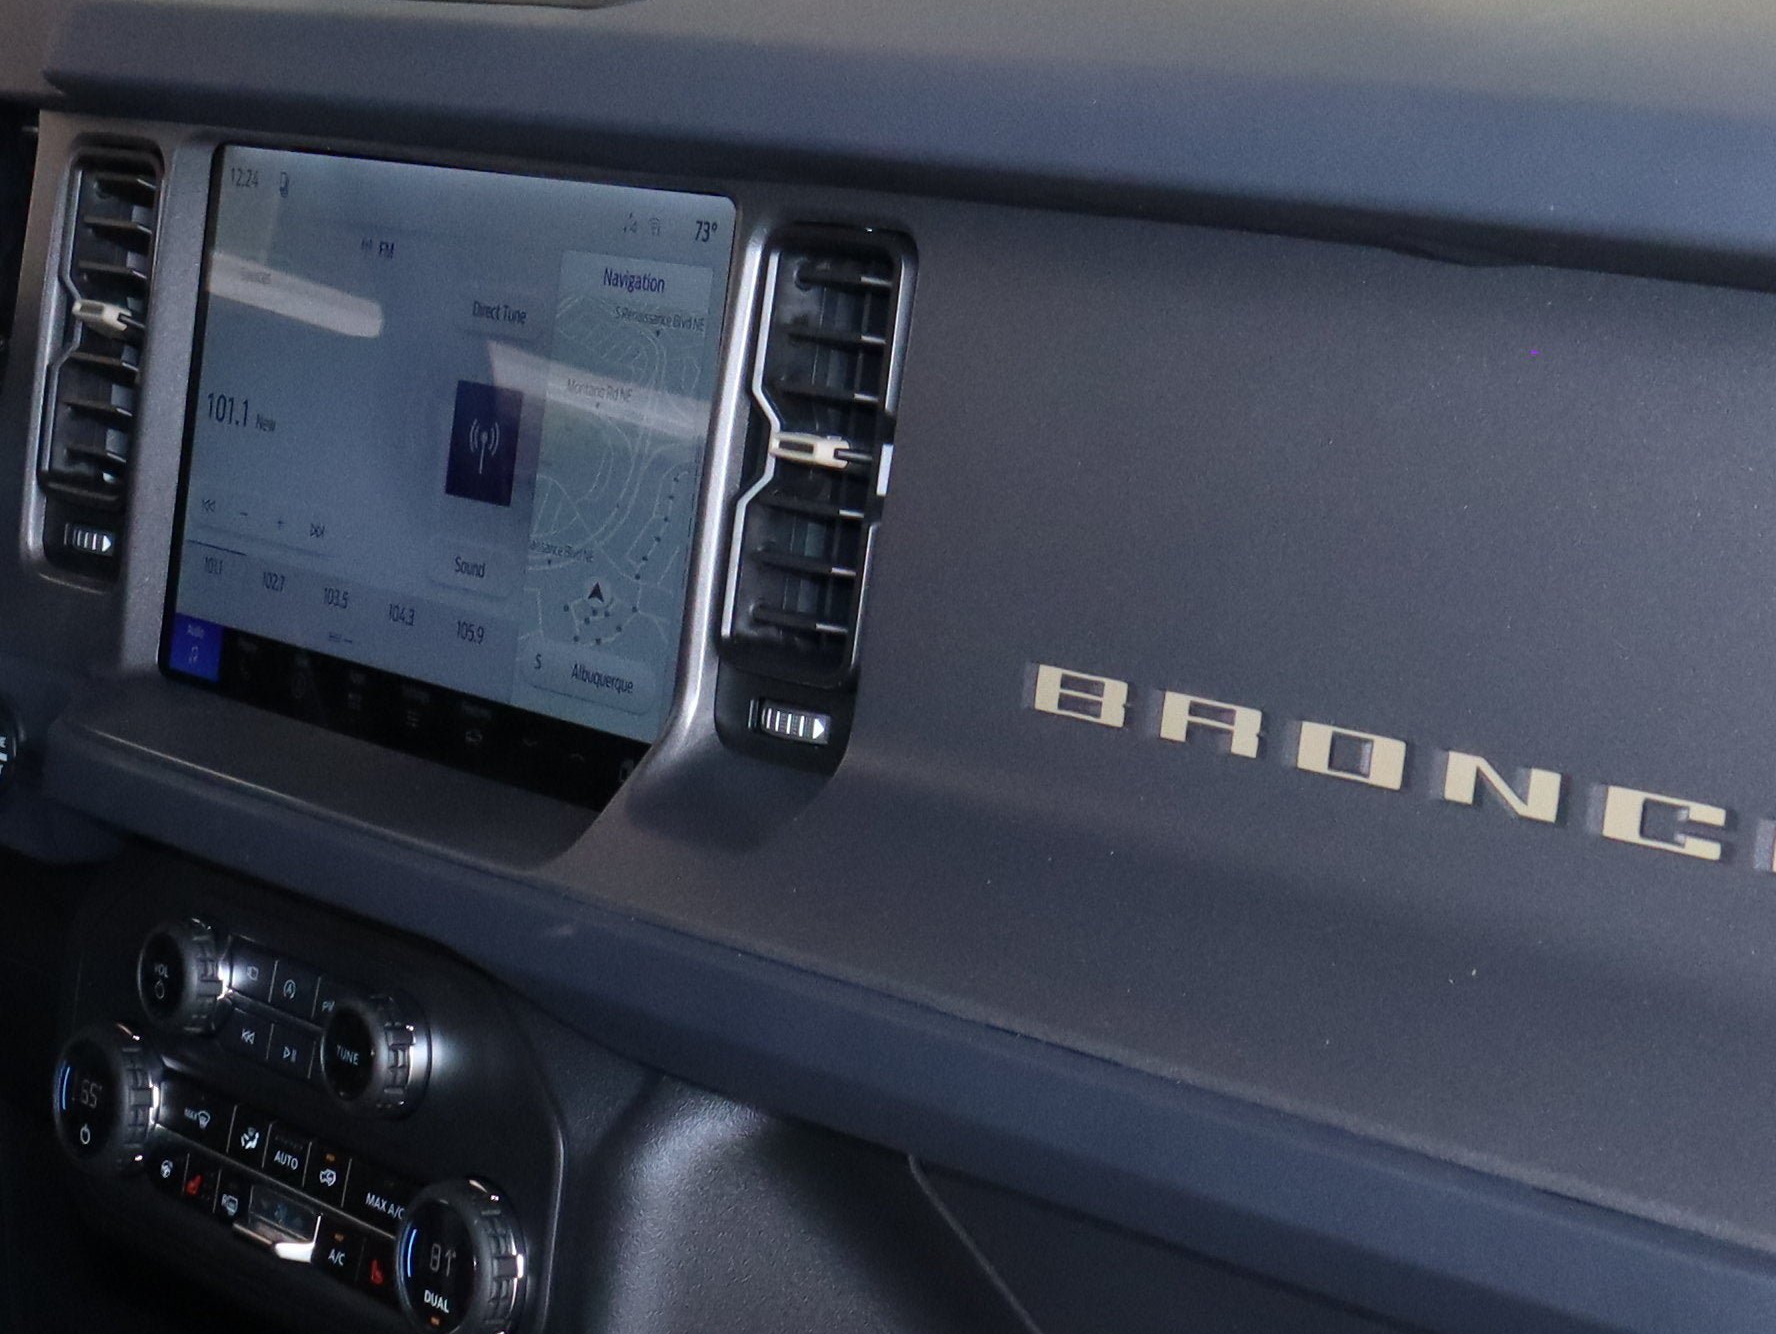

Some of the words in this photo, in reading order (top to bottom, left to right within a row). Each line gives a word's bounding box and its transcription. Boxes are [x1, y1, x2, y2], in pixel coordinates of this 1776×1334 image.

[693, 219, 719, 244] 73°
[602, 267, 666, 295] Navigation
[471, 301, 501, 322] Direct
[501, 307, 528, 326] Tune
[691, 317, 706, 332] NE
[207, 392, 249, 428] 101.1
[453, 554, 487, 580] Sound
[323, 587, 350, 610] 103.5
[387, 603, 416, 627] 104.3
[455, 619, 486, 646] 105.9
[534, 652, 542, 670] S
[571, 662, 634, 696] Albuquerque
[336, 1043, 360, 1066] TUNE
[273, 1150, 300, 1171] AUTO
[365, 1191, 388, 1214] MAX
[388, 1202, 405, 1221] A/C
[327, 1248, 346, 1267] A/C
[423, 1289, 450, 1314] DUAL
